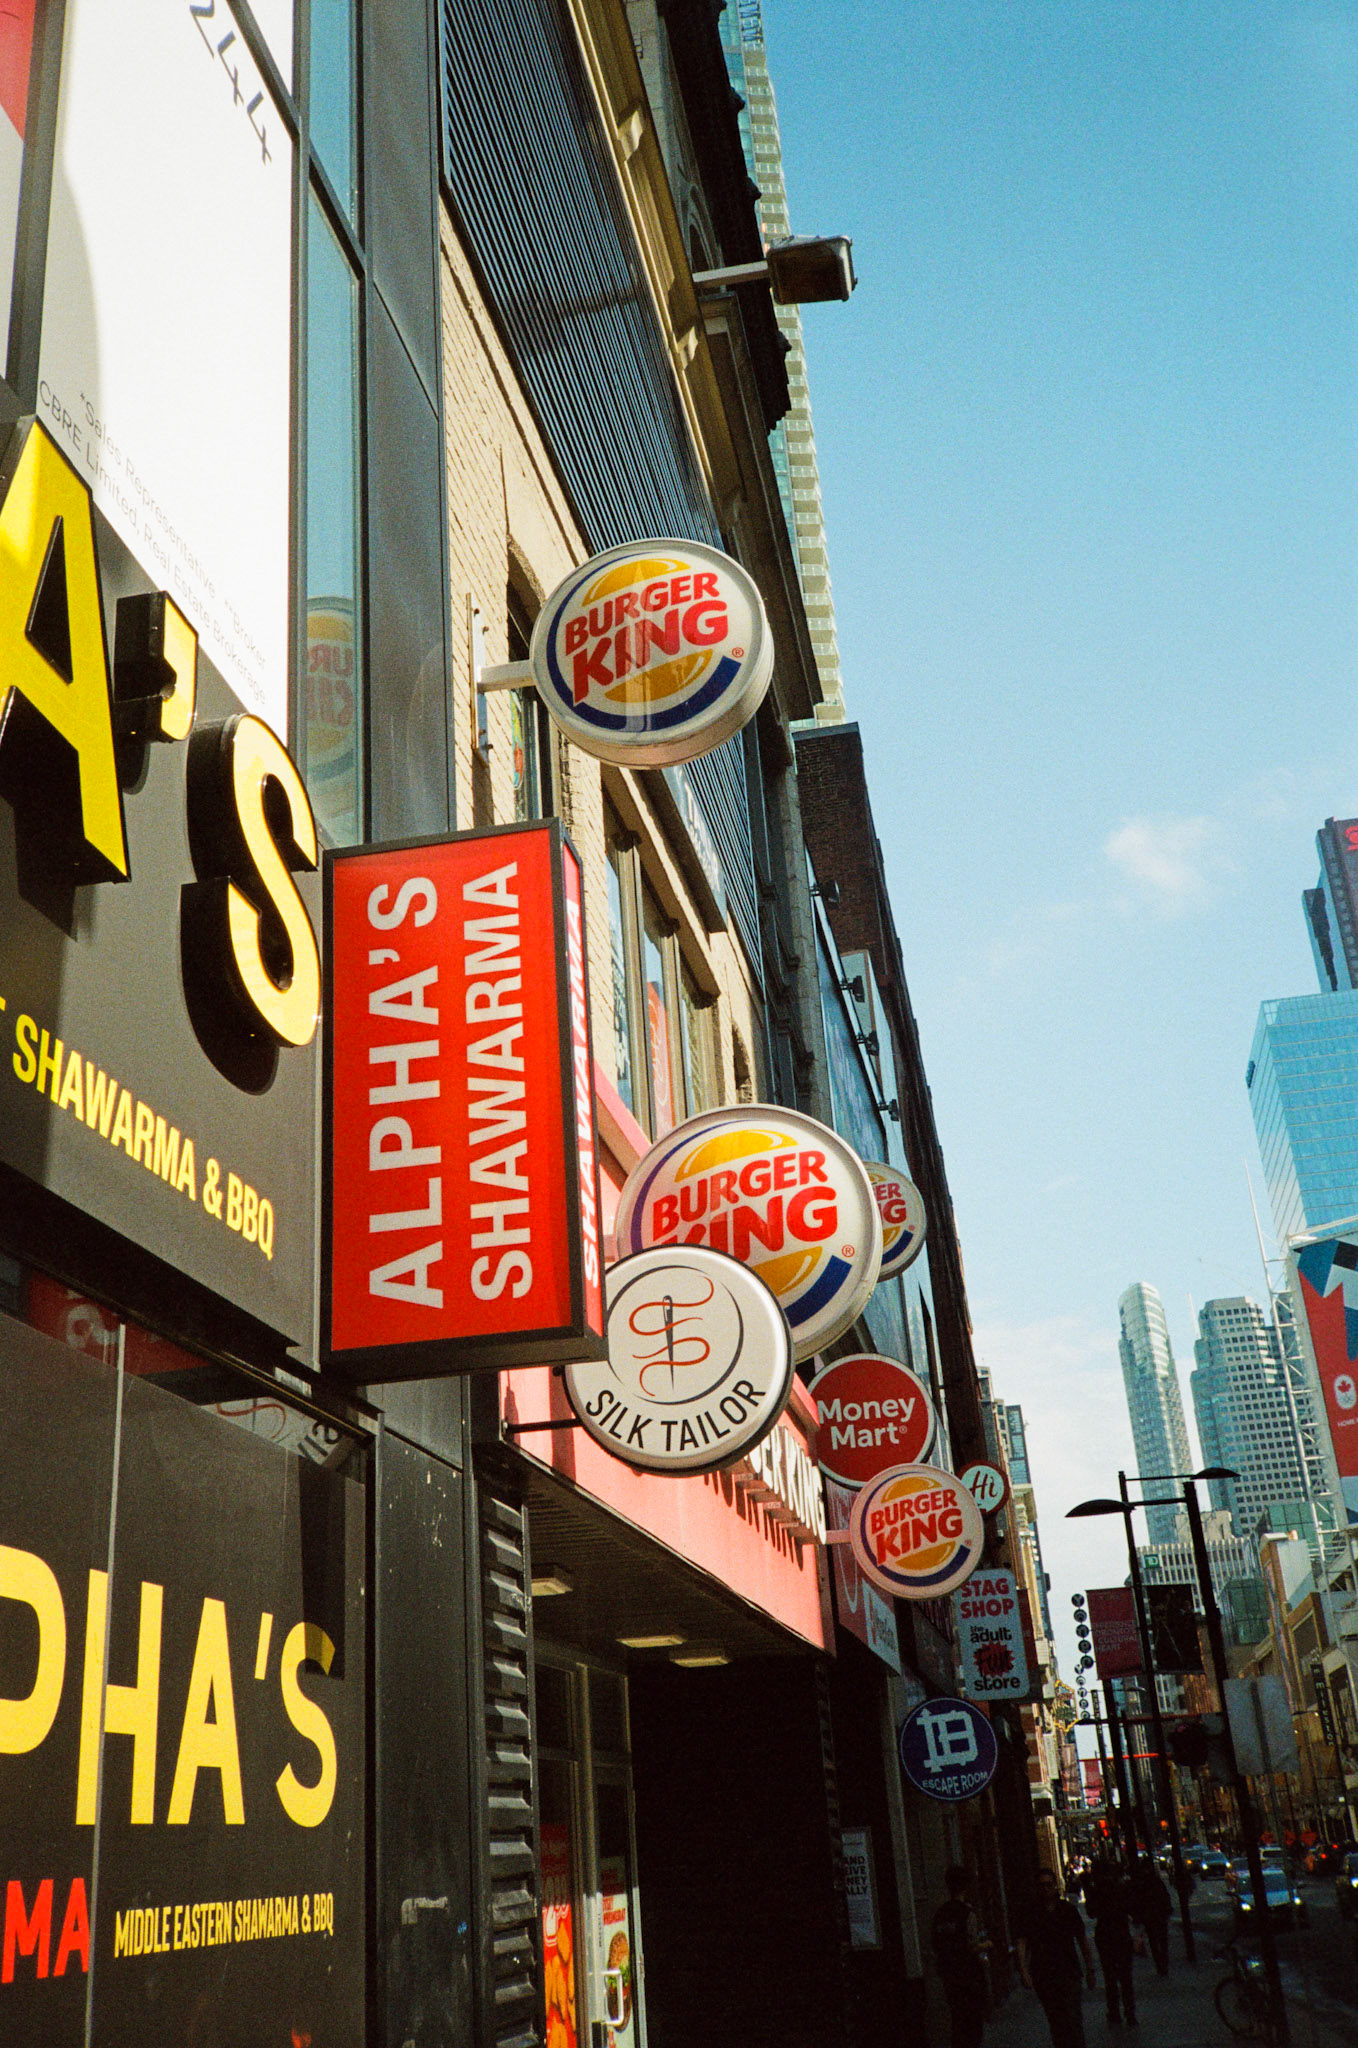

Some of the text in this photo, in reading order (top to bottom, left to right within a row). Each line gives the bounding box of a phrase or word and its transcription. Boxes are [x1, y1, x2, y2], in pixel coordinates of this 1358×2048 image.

[39, 380, 81, 452] CBRE
[144, 522, 171, 574] Real
[174, 563, 211, 629] Estate
[213, 619, 266, 705] Brokerage
[126, 457, 216, 600] Representative
[565, 572, 720, 657] BURGER
[573, 600, 729, 705] KING
[367, 875, 444, 1309] ALPHA'S
[462, 862, 533, 1300] SHAWARMA
[567, 897, 599, 1290] SHAWARMA
[12, 1014, 274, 1261] SHAWARMA & BBQ
[653, 1150, 829, 1243] BURGER
[585, 1379, 767, 1452] SILK TAILOR
[817, 1397, 916, 1424] Money
[870, 1488, 958, 1535] BURGER
[875, 1508, 964, 1565] KING
[960, 1598, 1014, 1619] SHOP
[961, 1577, 1010, 1598] STAG
[970, 1626, 1013, 1643] adult
[973, 1675, 1021, 1692] store
[922, 1770, 989, 1795] ESCAPE ROOM
[2, 1877, 90, 1983] MA
[114, 1892, 335, 1958] MIDDLE EASTERN SHAWARMA & BBQ
